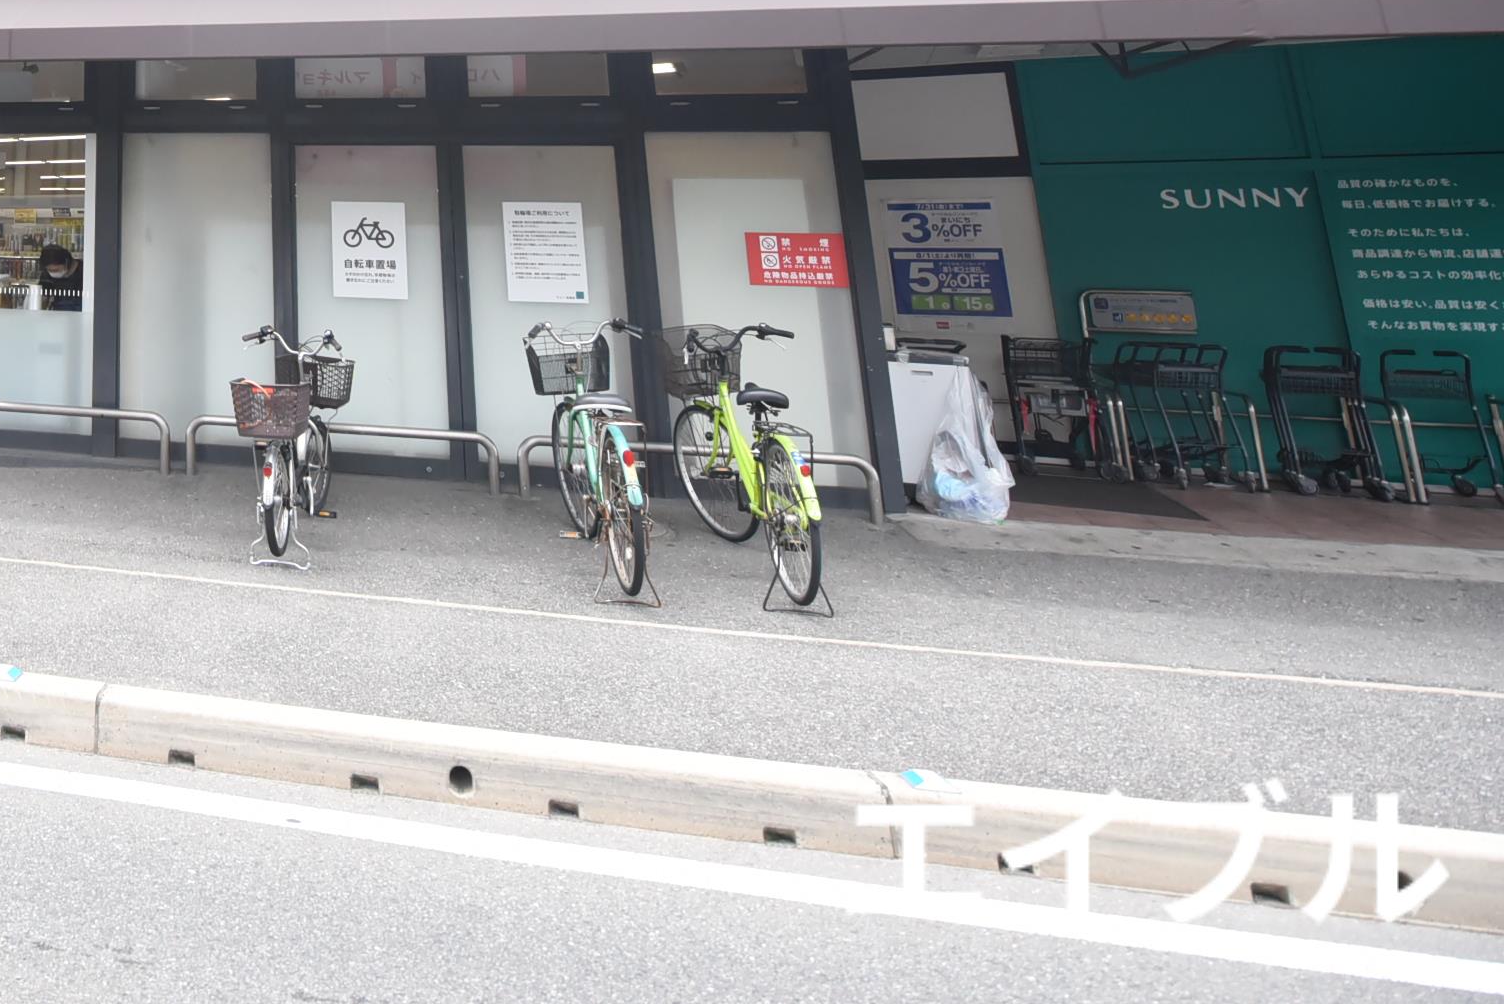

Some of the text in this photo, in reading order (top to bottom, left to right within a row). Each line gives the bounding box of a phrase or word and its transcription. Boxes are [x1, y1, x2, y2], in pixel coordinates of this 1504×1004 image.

[1337, 177, 1459, 189] 品質の確かなものを、
[1159, 187, 1309, 209] SUNNY
[1341, 198, 1497, 209] 毎日、低価格でお届けする。
[1348, 227, 1471, 238] そのために私たちは、
[1351, 248, 1504, 259] 商品調達から物流、店舗運
[344, 259, 397, 270] 自転車置場
[783, 255, 831, 265] 火気厳禁
[1357, 269, 1504, 281] あらゆるコストの効率化
[1362, 298, 1504, 310] 価格は安い。品質は安く
[1367, 320, 1504, 332] そんなお買物を実現す
